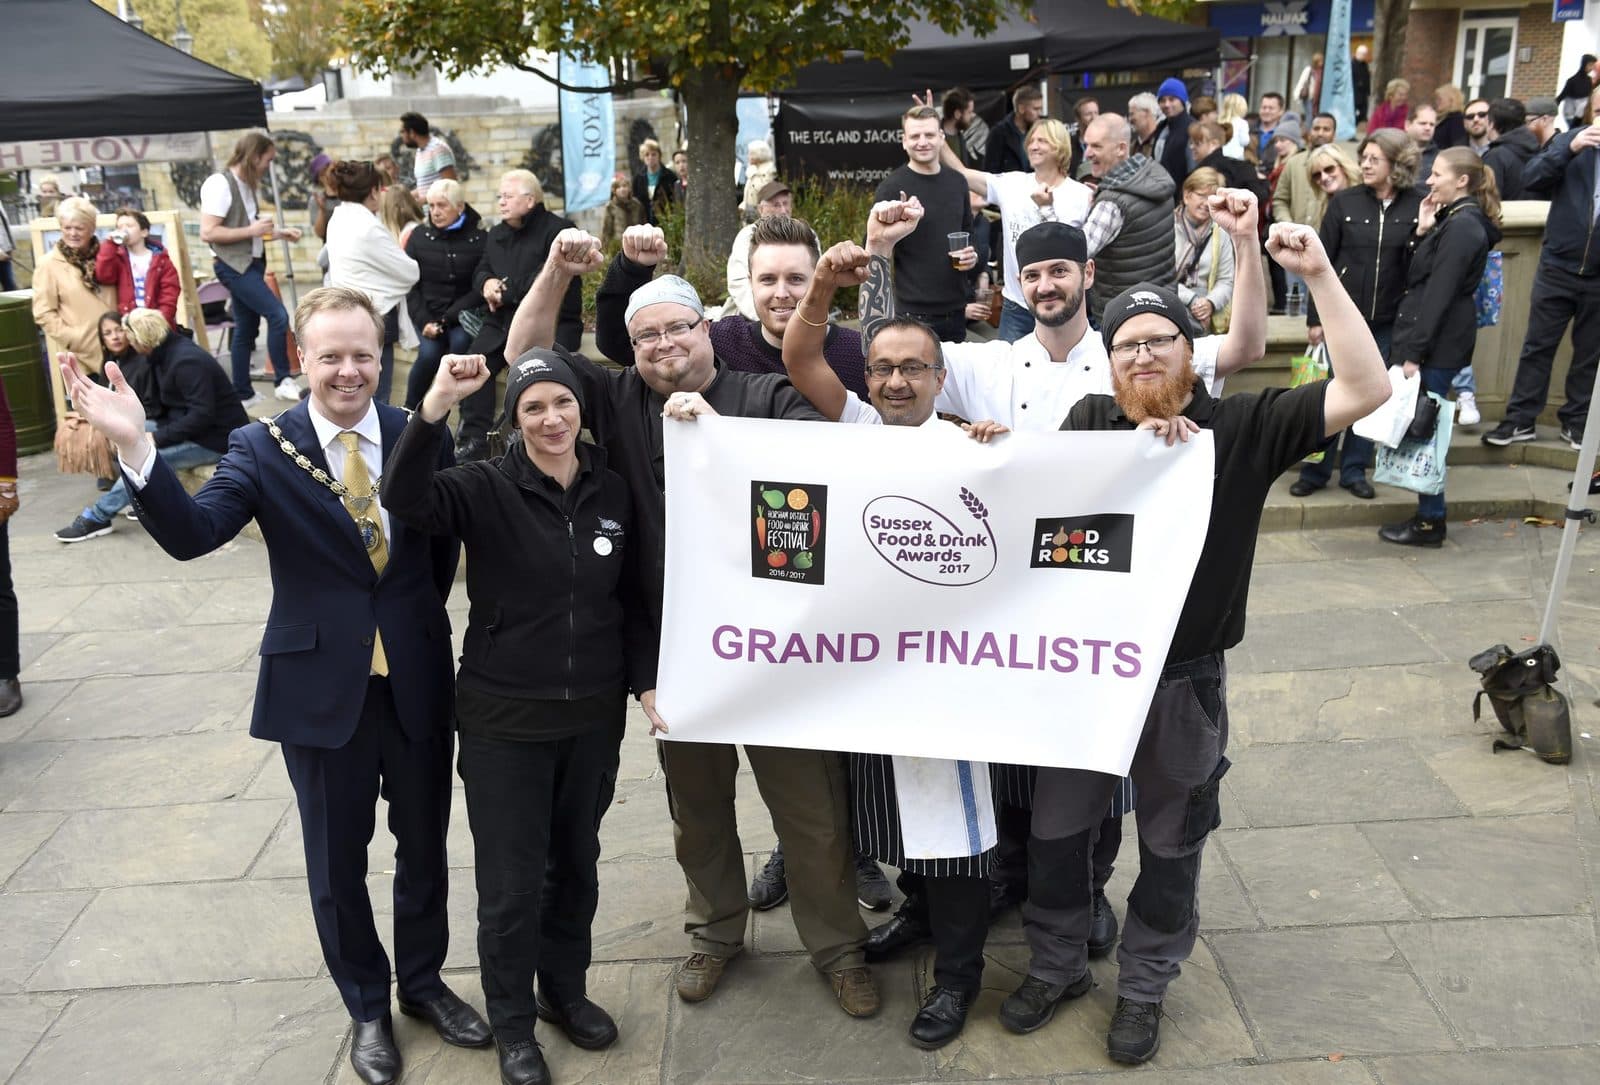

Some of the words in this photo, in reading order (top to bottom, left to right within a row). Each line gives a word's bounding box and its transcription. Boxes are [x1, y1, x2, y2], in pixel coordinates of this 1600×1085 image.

[1260, 11, 1309, 26] HALIFAX
[582, 79, 604, 159] ROYA
[788, 130, 810, 145] THE
[813, 130, 835, 145] PIG
[835, 130, 861, 144] AND
[863, 129, 904, 144] JACKE
[767, 510, 789, 519] HORSHAM
[789, 511, 810, 521] DISTRICT
[870, 515, 933, 531] Sussex
[767, 519, 784, 530] FOOD
[791, 521, 810, 532] DRINK
[767, 530, 809, 551] FESTIVAL
[877, 532, 922, 546] Food
[923, 533, 937, 547] &
[939, 533, 988, 547] Drink
[895, 548, 962, 562] Awards
[938, 564, 970, 574] 2017
[711, 624, 881, 664] GRAND
[896, 630, 1142, 679] FINALISTS
